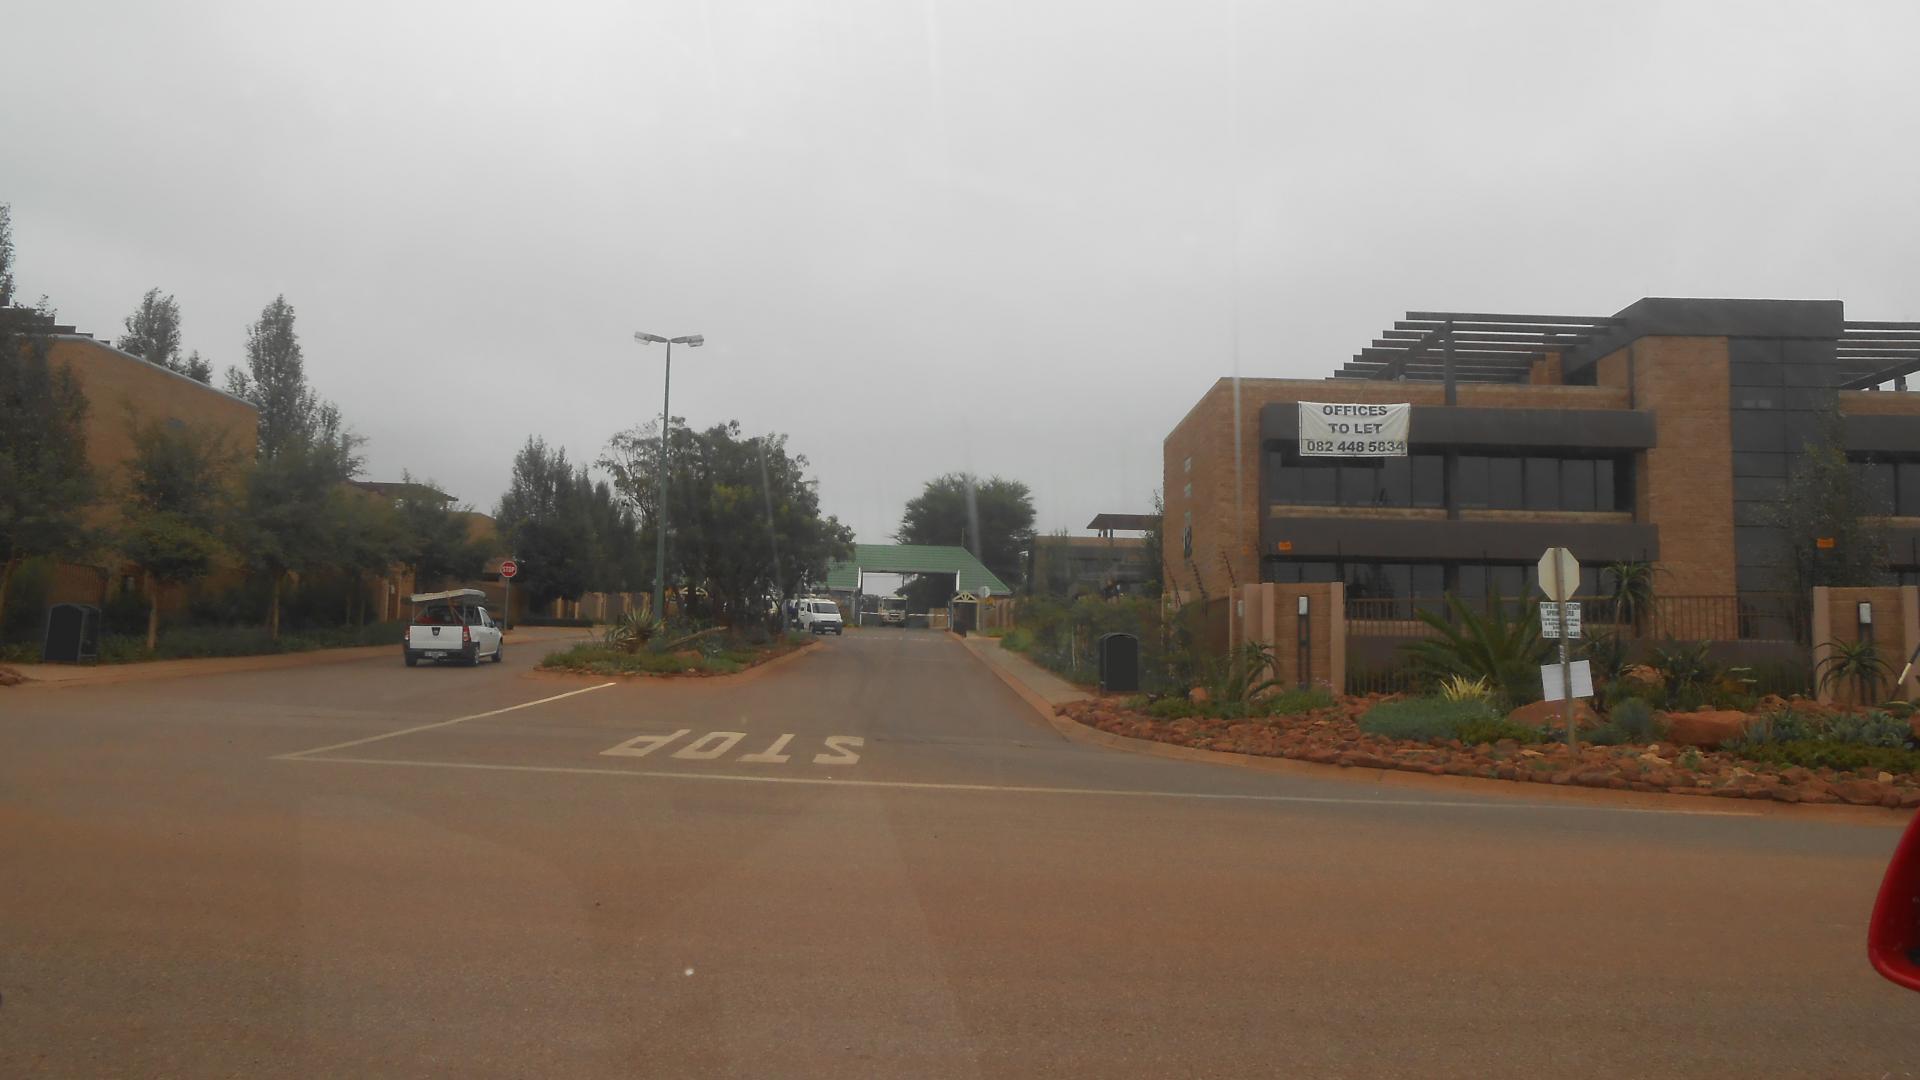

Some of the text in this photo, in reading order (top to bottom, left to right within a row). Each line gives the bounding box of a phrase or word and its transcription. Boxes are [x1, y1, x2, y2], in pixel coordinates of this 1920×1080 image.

[1322, 405, 1388, 416] OFFICES
[1328, 423, 1383, 434] TO LET
[1307, 441, 1405, 452] 082 448 5834
[598, 728, 865, 765] STOP
